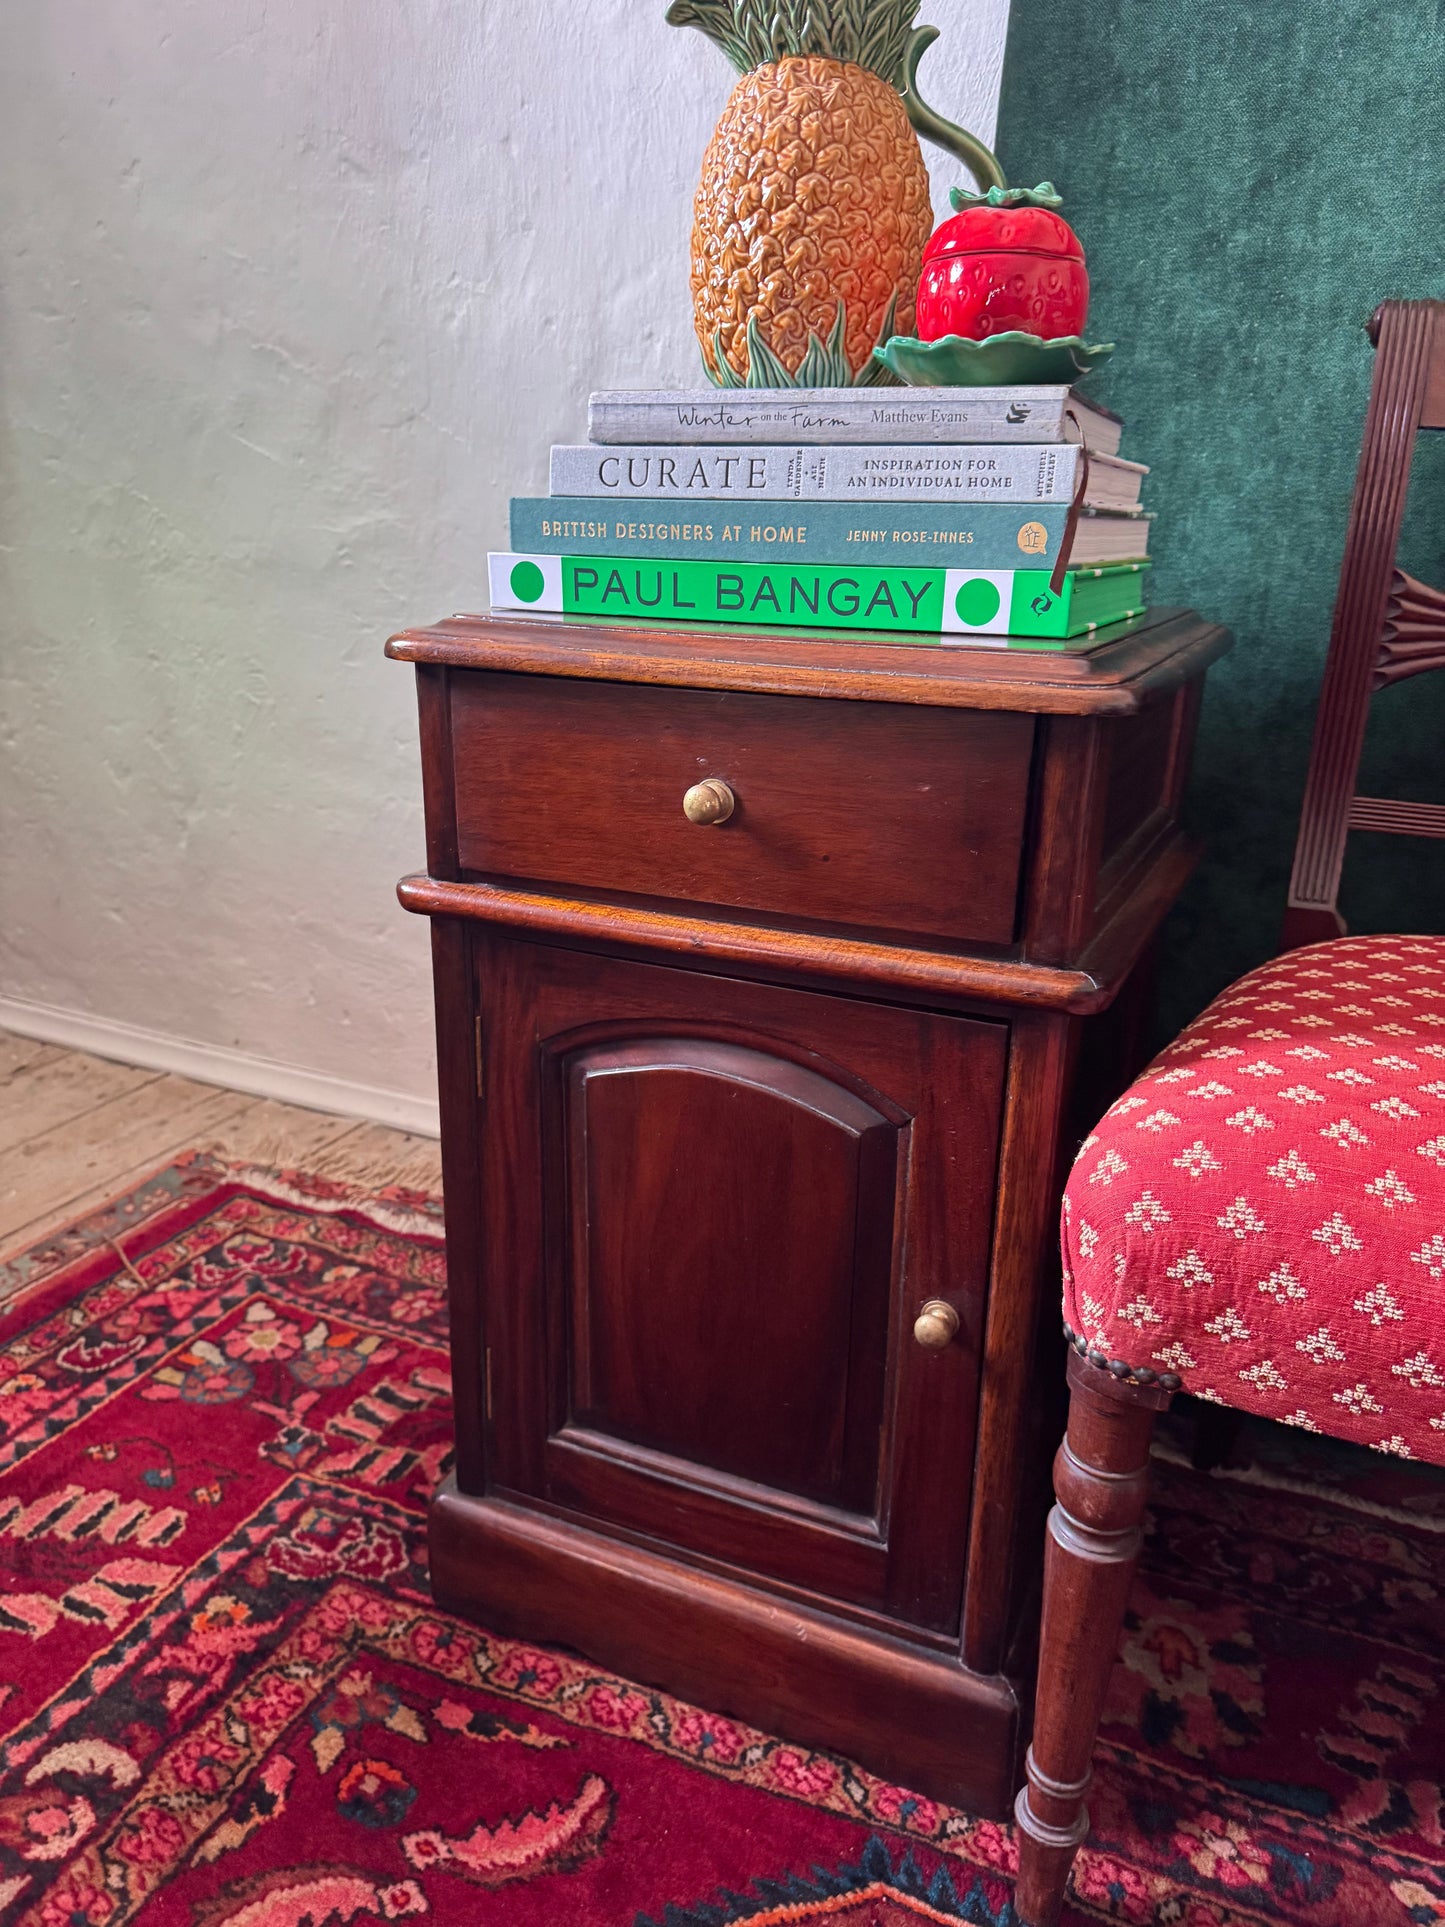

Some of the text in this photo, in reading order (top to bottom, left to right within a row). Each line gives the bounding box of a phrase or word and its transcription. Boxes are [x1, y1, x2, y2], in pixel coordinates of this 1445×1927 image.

[677, 405, 851, 429] Winter on the Farm
[871, 409, 968, 423] Matthew Evans
[598, 456, 768, 489] CURATE
[794, 449, 803, 497] GARDENER
[818, 457, 826, 489] HEATH
[865, 459, 997, 471] INSPIRATION FOR
[1037, 449, 1047, 498] MITCHELL
[1046, 453, 1056, 494] BEAZLEY
[847, 477, 1012, 488] AN INDIVIDUAL HOME
[541, 520, 807, 543] BRITISH DESIGNERS AT HOME
[846, 530, 974, 544] JENNY ROSE-INNES
[573, 567, 933, 619] PAUL BANGAY
